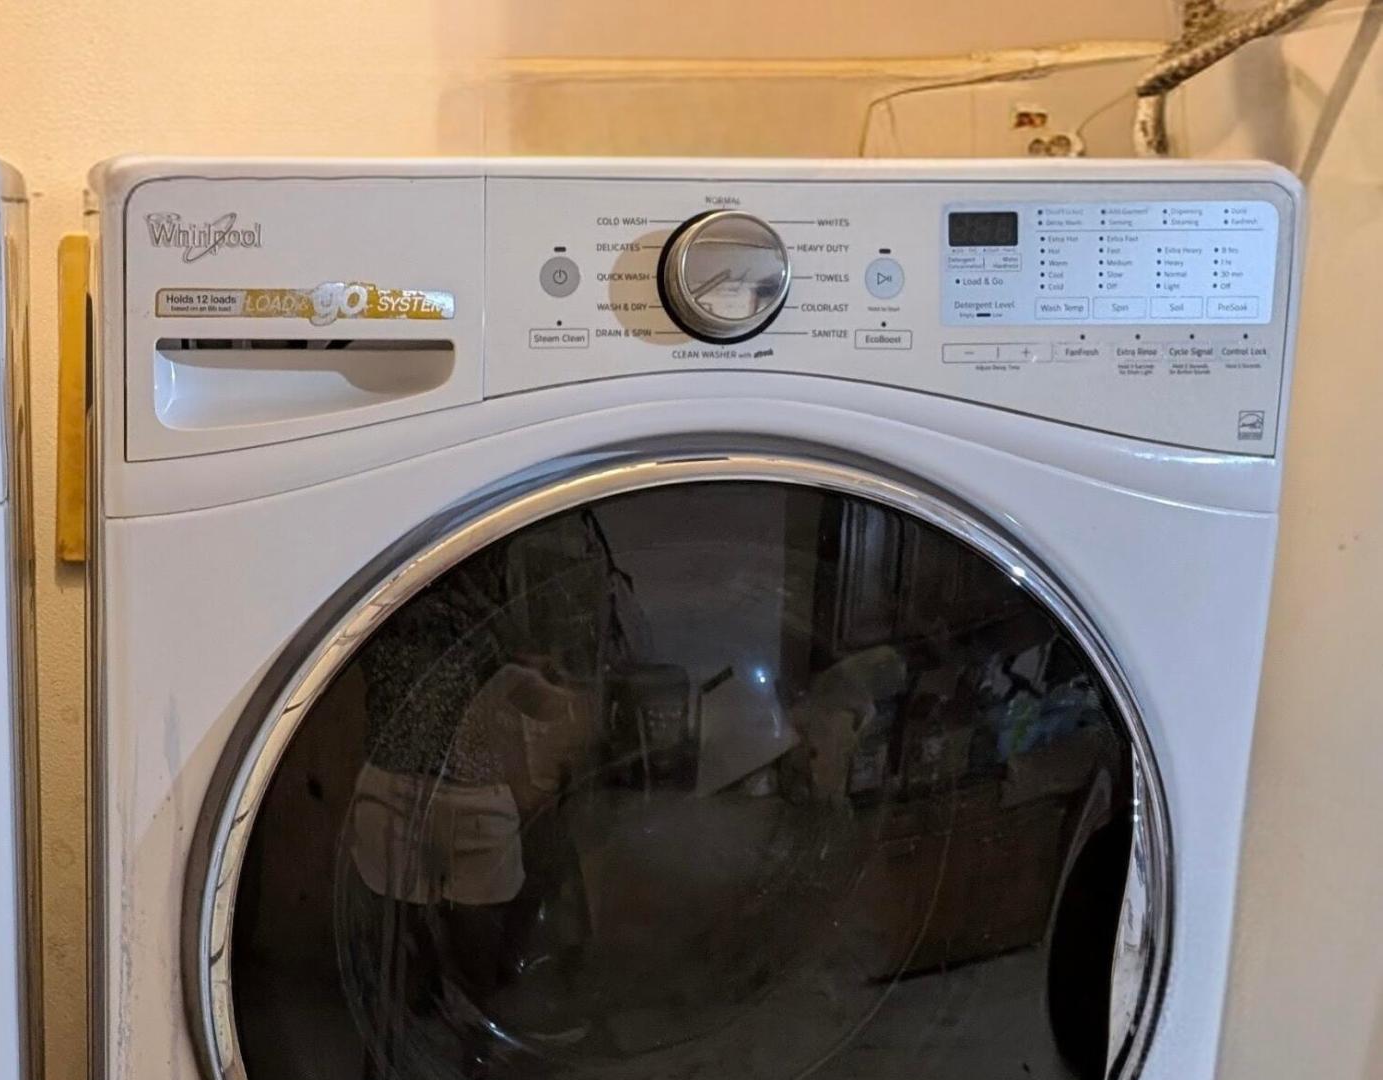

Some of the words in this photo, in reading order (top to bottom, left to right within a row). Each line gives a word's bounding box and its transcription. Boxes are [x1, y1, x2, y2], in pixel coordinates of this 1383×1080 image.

[596, 217, 620, 226] COLD
[622, 217, 648, 226] WASH
[817, 218, 850, 227] WHITES
[146, 216, 263, 258] Whirlpool
[596, 243, 640, 252] DELICATES
[796, 244, 824, 253] HEAVY
[826, 244, 850, 253] DUTY
[1107, 259, 1133, 267] Medium
[596, 273, 625, 281] QUICK
[625, 273, 650, 281] WASH
[814, 273, 850, 282] TOWELS
[963, 277, 982, 286] Load
[992, 277, 1004, 286] Go
[1220, 282, 1231, 290] Off
[166, 294, 194, 304] Holds
[197, 294, 208, 304] 12
[210, 294, 237, 304] loads
[245, 294, 295, 311] LOAD
[312, 282, 368, 325] go
[597, 302, 622, 311] WASH
[630, 302, 648, 311] DRY
[800, 303, 849, 312] COLORLAST
[954, 301, 992, 311] Detergent
[994, 301, 1015, 309] Level
[1040, 304, 1061, 312] Wash
[1064, 304, 1084, 313] Temp
[1112, 303, 1129, 313] Spin
[1169, 303, 1184, 312] Soil
[1218, 303, 1248, 312] PreSoak
[595, 328, 622, 337] DRAIN
[632, 328, 652, 337] SPIN
[811, 329, 848, 338] SANITIZE
[533, 334, 560, 343] Steam
[562, 334, 585, 343] Clean
[864, 334, 902, 344] EcoBoost
[671, 350, 699, 359] CLEAN
[701, 350, 737, 359] WASHER
[1065, 347, 1099, 357] FanFresh
[1116, 347, 1136, 356] Extra
[1137, 347, 1157, 356] Rinse
[1169, 347, 1188, 357] Cycle
[1190, 347, 1214, 357] Signal
[1221, 347, 1249, 356] Control
[1250, 347, 1267, 356] Lock
